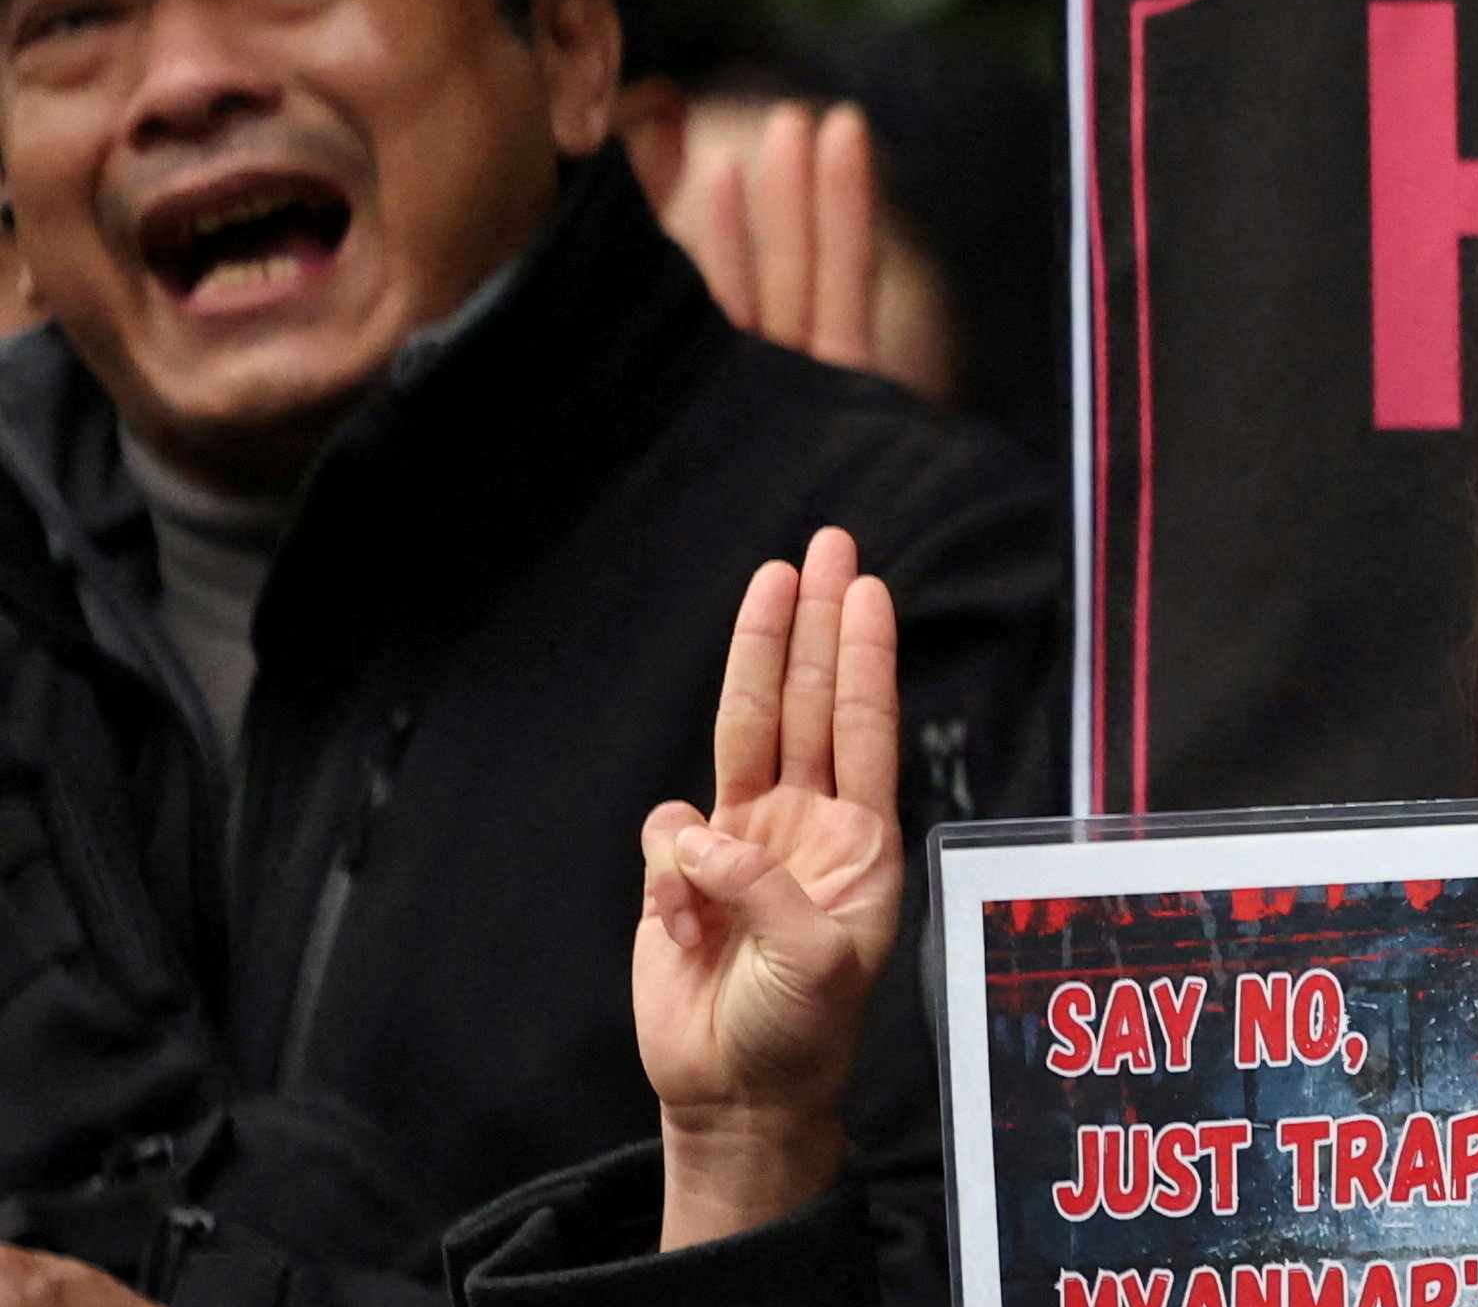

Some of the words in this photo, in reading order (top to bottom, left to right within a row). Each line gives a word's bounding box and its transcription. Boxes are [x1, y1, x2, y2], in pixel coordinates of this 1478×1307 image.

[1046, 974, 1208, 1078] SAY
[1234, 966, 1368, 1076] NO,
[1053, 1120, 1252, 1222] JUST
